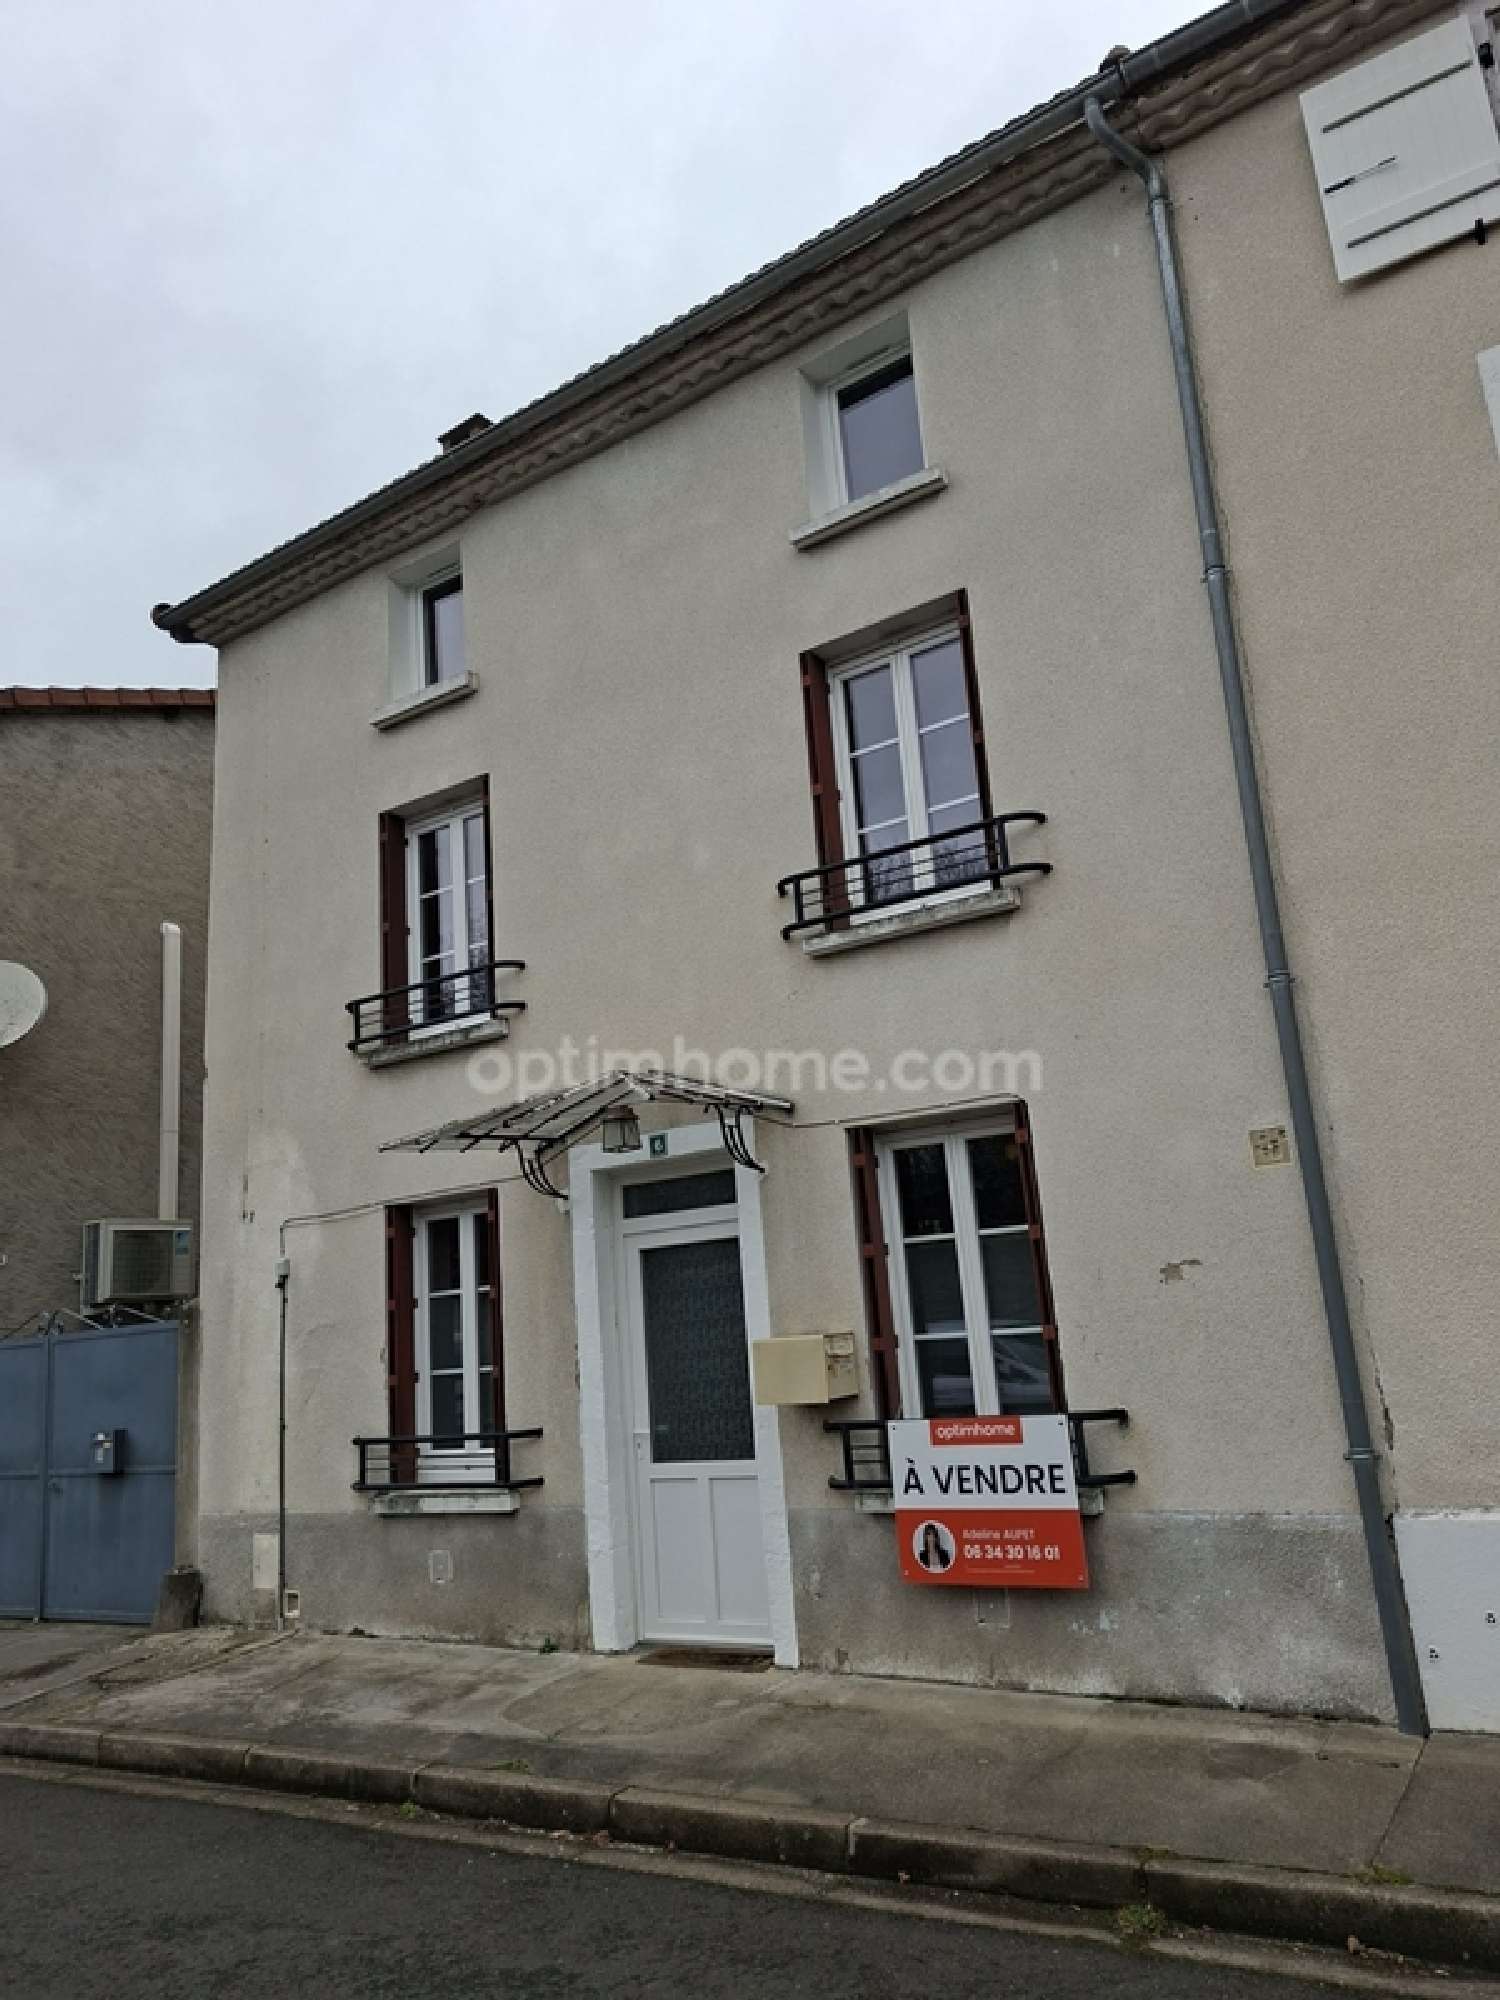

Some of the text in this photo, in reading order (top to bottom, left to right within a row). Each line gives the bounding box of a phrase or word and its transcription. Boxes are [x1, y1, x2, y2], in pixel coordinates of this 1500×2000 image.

[937, 1422, 1016, 1440] optimhome
[903, 1457, 1067, 1494] À VENDRE
[963, 1544, 982, 1559] 06
[984, 1544, 1003, 1559] 34
[1005, 1544, 1024, 1559] 30
[1044, 1544, 1061, 1560] 01
